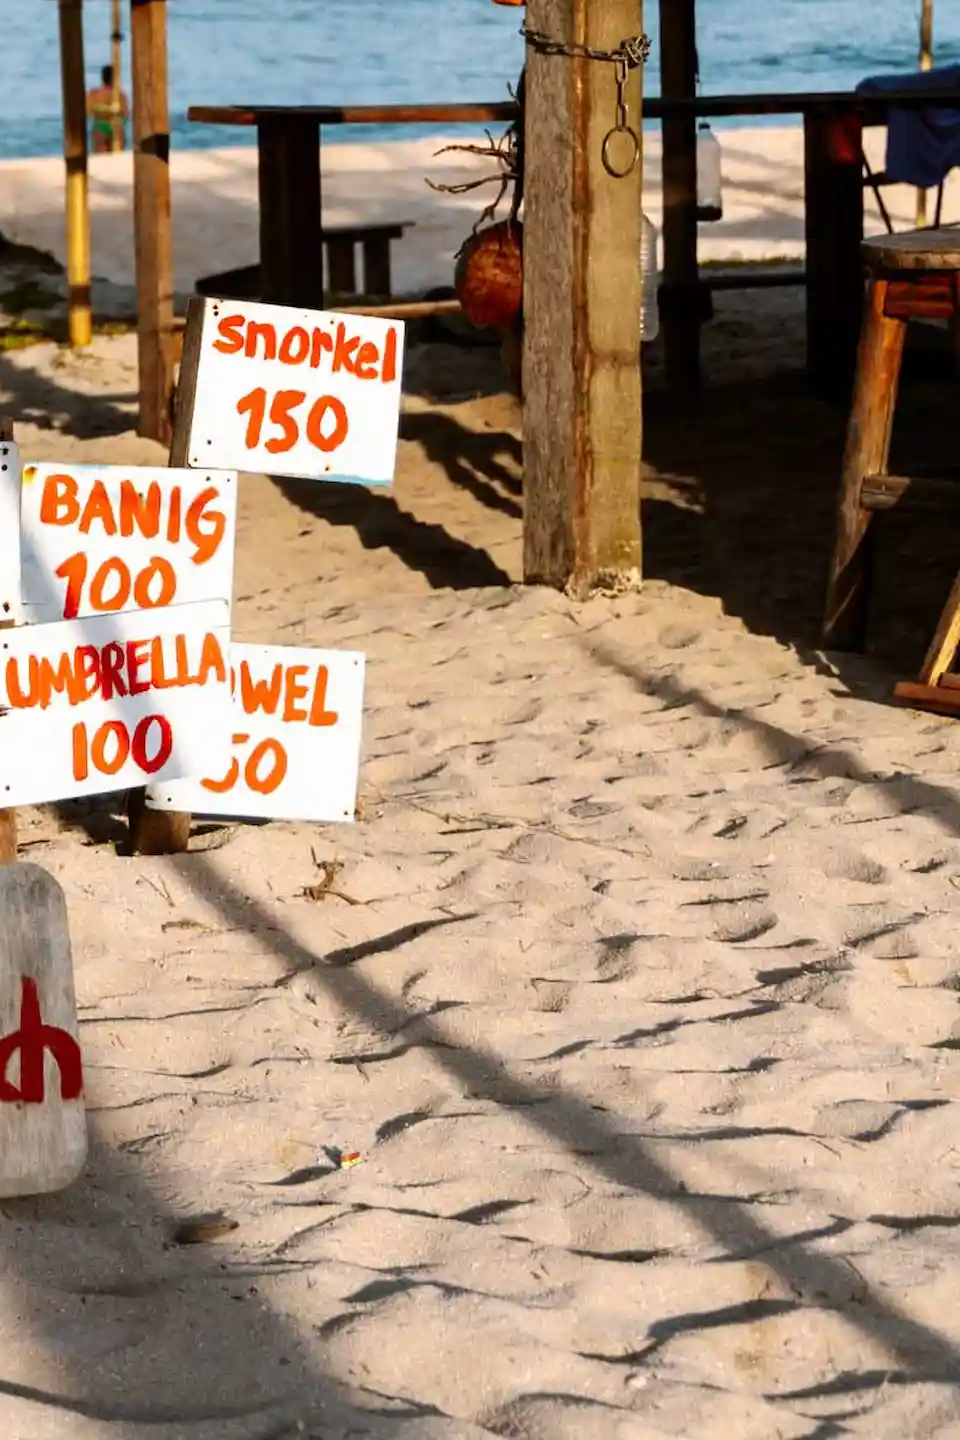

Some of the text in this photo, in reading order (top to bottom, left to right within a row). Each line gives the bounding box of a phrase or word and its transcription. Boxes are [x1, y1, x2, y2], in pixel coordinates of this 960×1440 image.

[212, 314, 398, 383] snorkel
[237, 388, 349, 454] 150
[40, 474, 227, 565] BANIG
[56, 552, 177, 621] 100
[5, 633, 227, 709] UMBRELLA
[230, 661, 338, 727] WEL
[71, 714, 173, 782] 100
